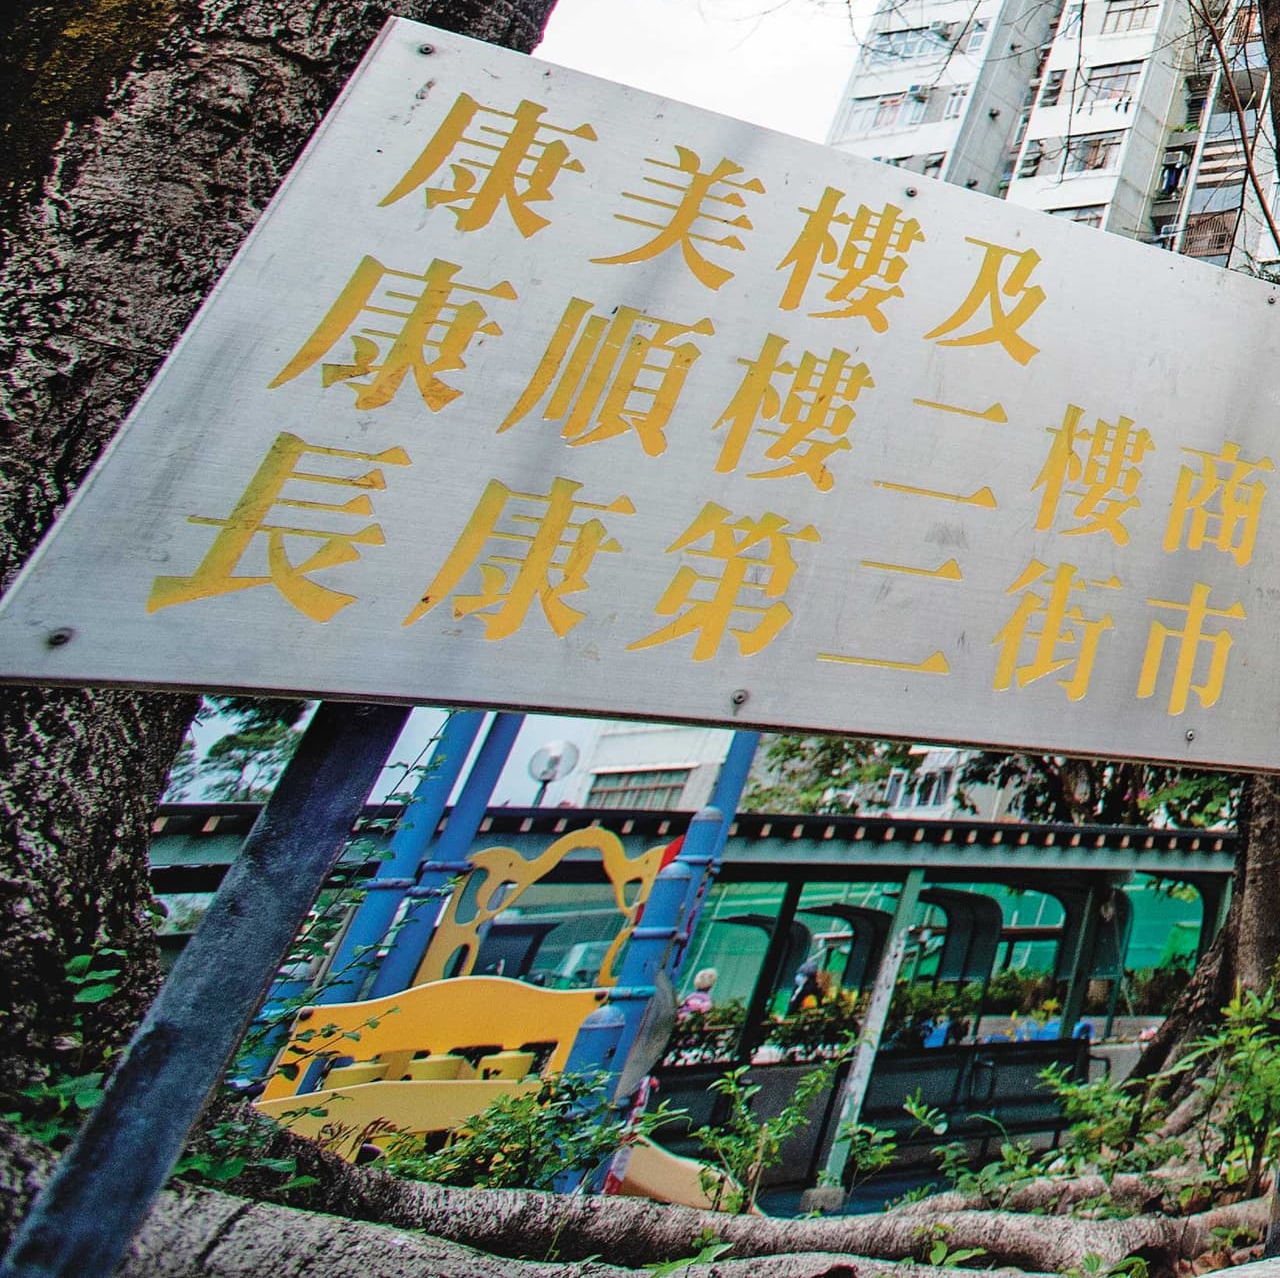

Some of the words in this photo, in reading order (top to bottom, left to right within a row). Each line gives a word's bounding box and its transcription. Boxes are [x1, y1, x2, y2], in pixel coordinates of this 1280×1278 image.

[380, 94, 1045, 365] 康美樓及
[147, 434, 1246, 714] 長康第二街市
